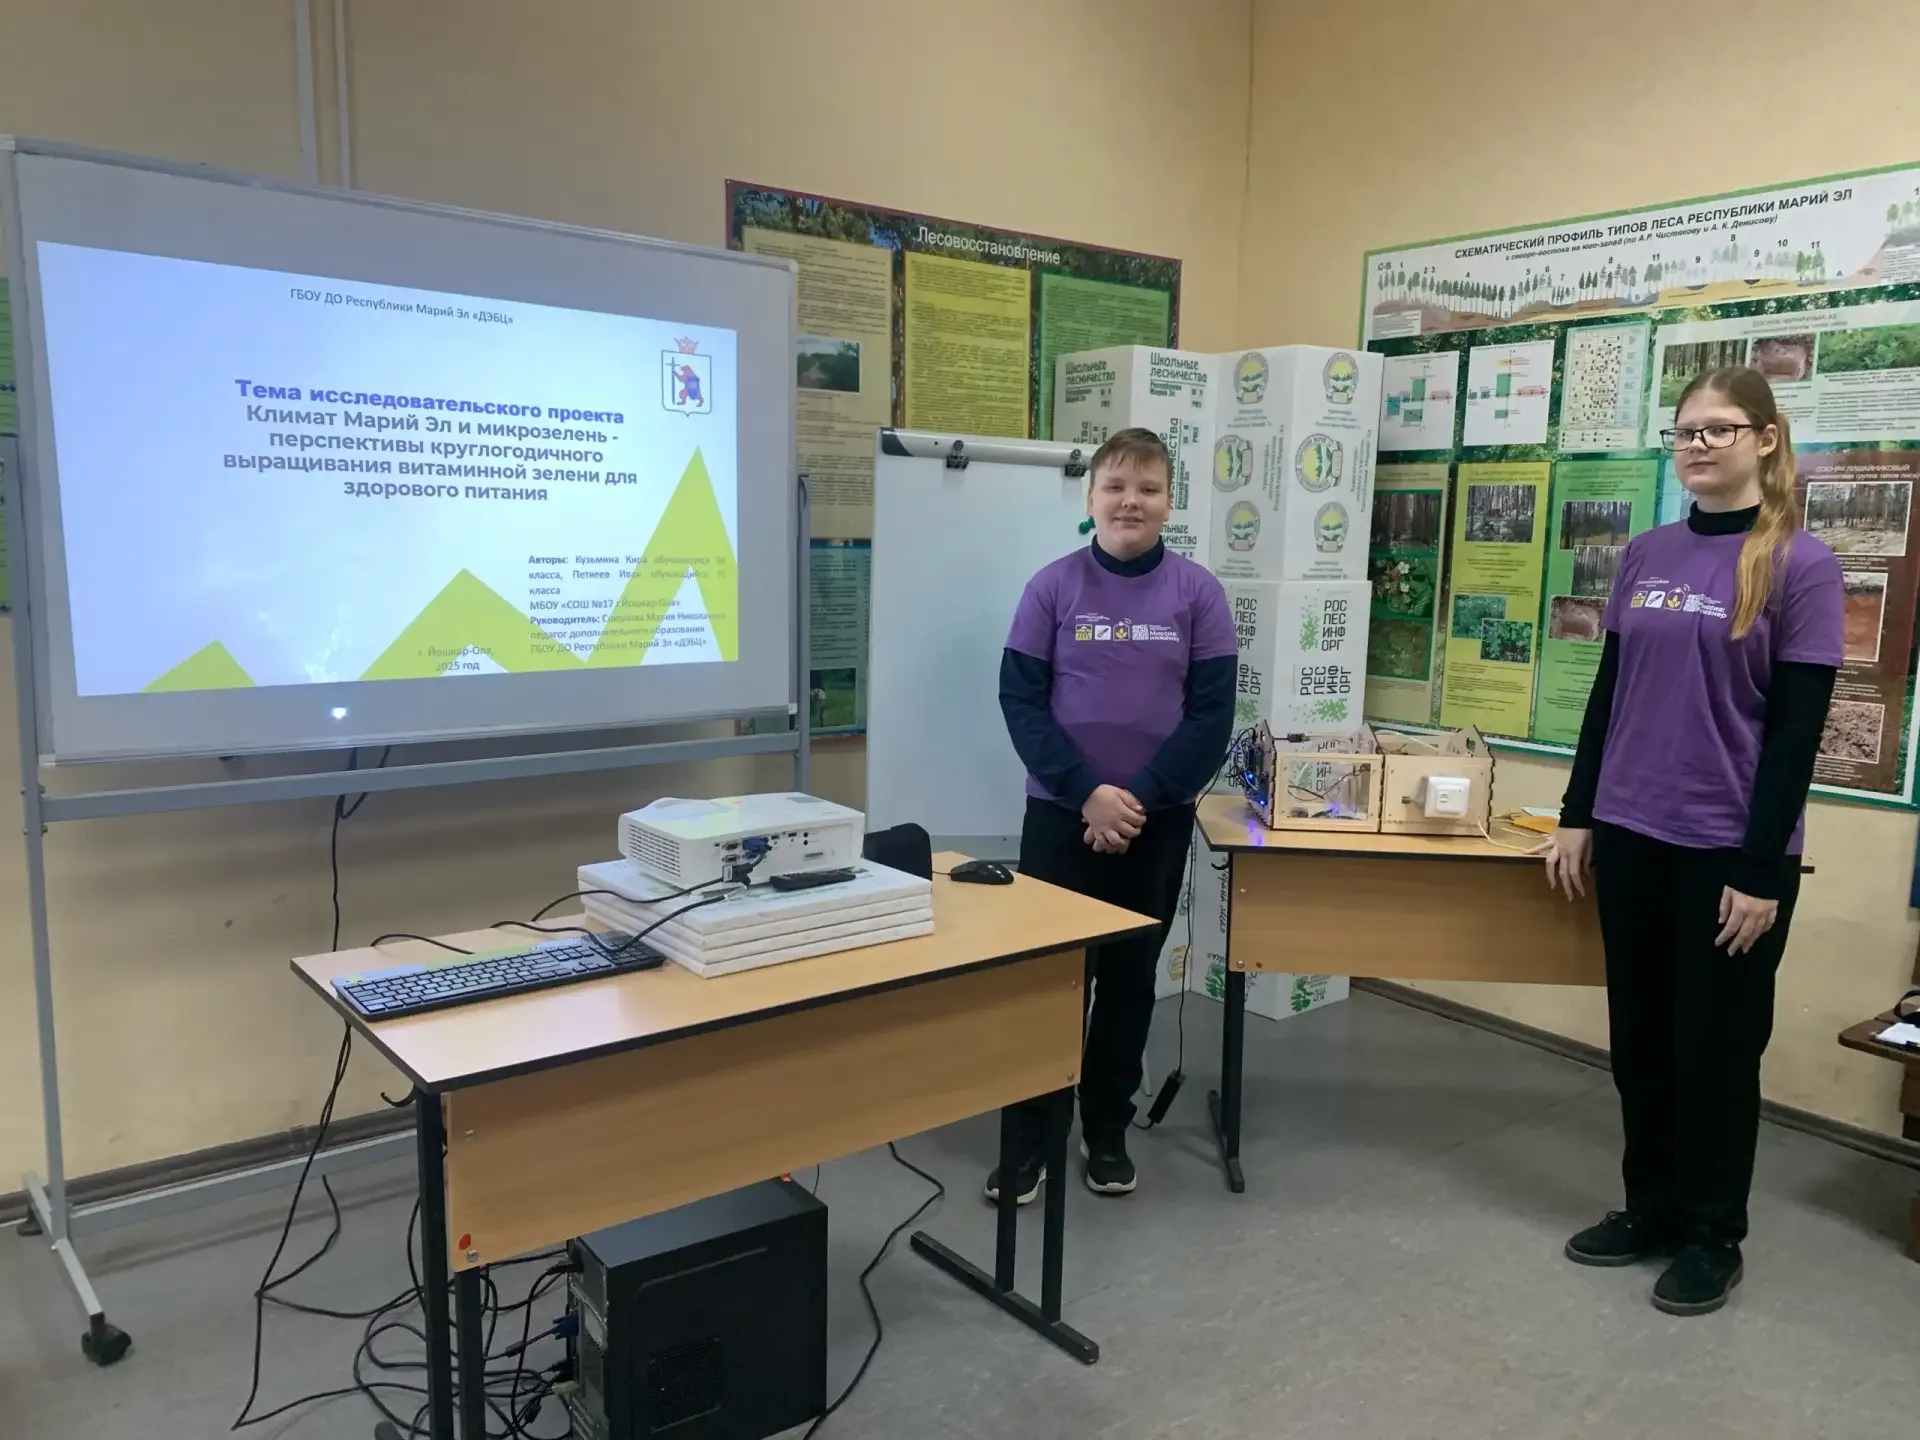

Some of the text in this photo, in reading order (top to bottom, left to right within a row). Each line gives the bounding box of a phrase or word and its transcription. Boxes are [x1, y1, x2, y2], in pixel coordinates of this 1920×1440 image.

[1454, 188, 1853, 260] СХЕМАТИЧЕСКИЙ ПРОФИЛЬ ТИПОВ ЛЕСА РЕСПУБЛИКИ МАРИЙ ЭЛ
[1655, 226, 1702, 240] Чистякову
[1730, 213, 1778, 230] Денисову)
[1730, 233, 1736, 242] 8
[1777, 238, 1789, 248] 10
[917, 225, 1061, 266] Лесовосстановление
[1809, 240, 1821, 250] 11
[1608, 256, 1614, 265] 8
[1651, 252, 1661, 262] 11
[1695, 255, 1701, 264] 9
[1754, 249, 1760, 258] 9
[1525, 267, 1532, 276] 5
[290, 287, 514, 326] ГБОУ ДО Республики Марий Эл «ДЭБЦ»
[1065, 360, 1108, 375] Школьные
[1150, 351, 1199, 371] Школьные
[1065, 371, 1116, 386] лесничества
[1149, 366, 1208, 383] лесничества
[234, 378, 625, 425] Тема исследовательского проекта
[246, 404, 338, 428] Климат
[343, 410, 420, 433] Марий
[424, 415, 452, 434] Эл
[458, 420, 471, 435] и
[477, 421, 608, 444] микрозелень
[269, 431, 604, 463] перспективы круглогодичного
[223, 453, 638, 486] выращивания витаминной зелени для
[343, 480, 548, 502] здорового питания
[1161, 523, 1189, 535] льные
[1163, 535, 1197, 546] ичества
[528, 555, 569, 566] Авторы:
[575, 555, 620, 566] Кузьмина
[625, 555, 648, 566] Кира
[528, 571, 563, 581] класса,
[618, 569, 642, 578] Иван
[529, 587, 561, 596] класса
[529, 600, 559, 611] МБОУ
[561, 599, 590, 610] «СОШ
[591, 599, 614, 609] №17
[1235, 597, 1258, 611] РОС
[1323, 599, 1348, 612] РОС
[530, 614, 600, 626] Руководитель:
[1234, 610, 1257, 624] ЛЕС
[1322, 612, 1347, 625] ЛЕС
[530, 630, 568, 641] педагог
[650, 624, 705, 636] образования
[1321, 626, 1346, 638] ИНФ
[530, 643, 557, 653] ГБОУ
[557, 643, 572, 654] ДО
[629, 639, 660, 650] Марий
[661, 638, 672, 647] Эл
[674, 637, 707, 648] «ДЭБЦ»
[1321, 639, 1344, 652] ОРГ
[435, 660, 481, 672] 2025 год
[1237, 663, 1250, 694] ИНФ
[1249, 665, 1263, 696] ОРГ
[1299, 666, 1314, 696] РОС
[1313, 665, 1327, 695] ЛЕС
[1326, 665, 1339, 695] ИНФ
[1338, 665, 1352, 694] ОРГ
